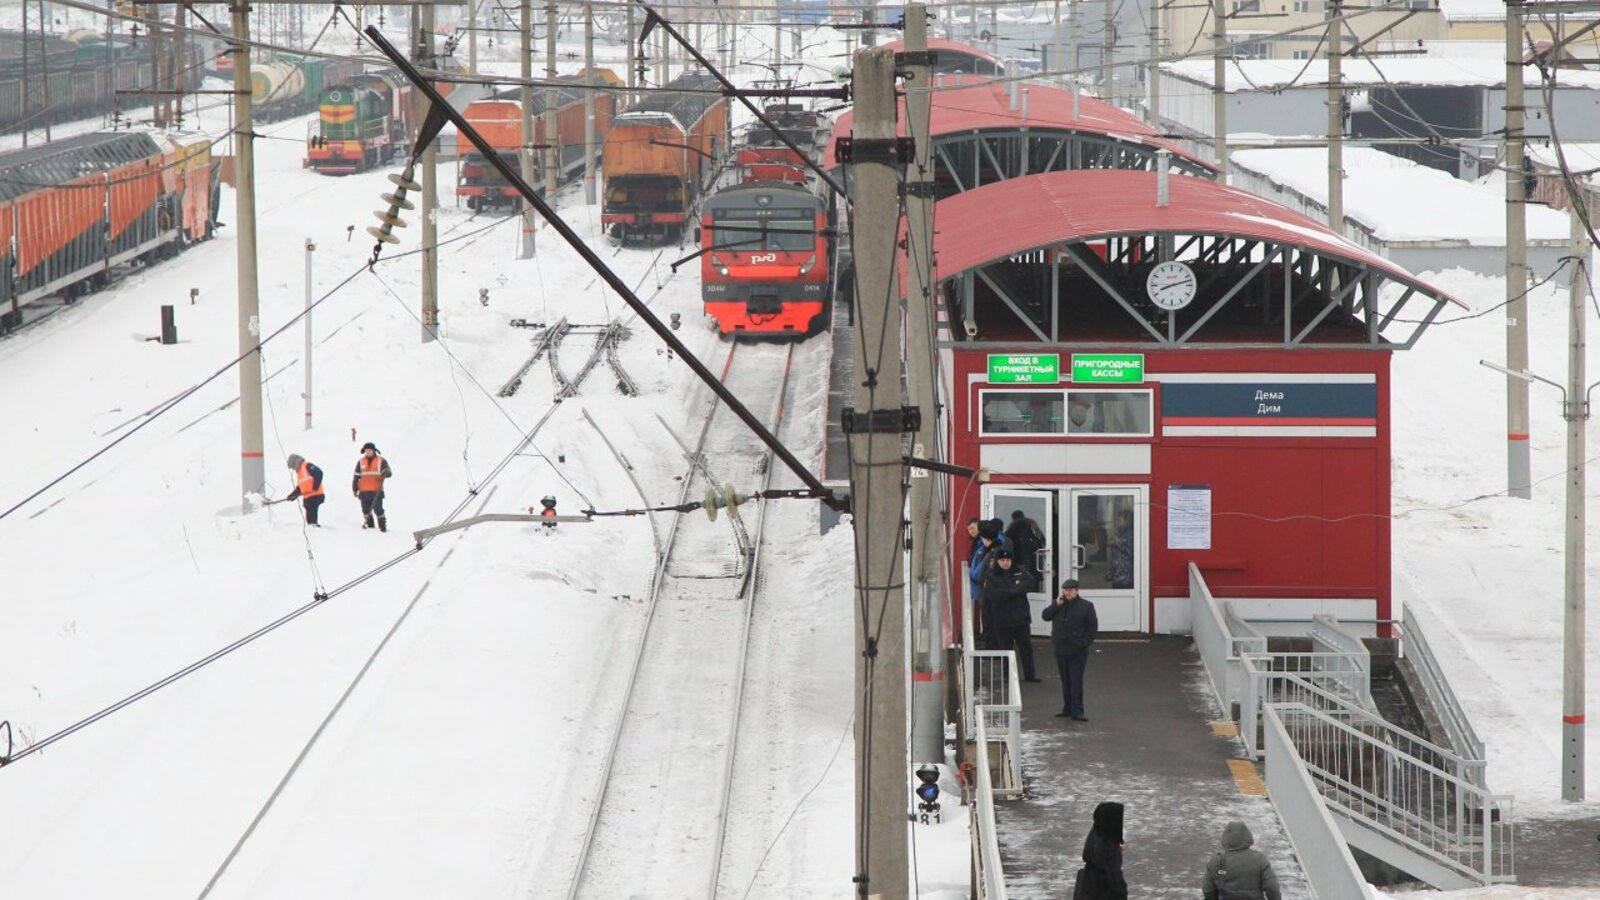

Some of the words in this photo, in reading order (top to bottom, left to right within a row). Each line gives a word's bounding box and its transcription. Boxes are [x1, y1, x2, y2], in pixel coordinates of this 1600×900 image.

[1008, 357, 1031, 365] ВХОД
[1074, 360, 1141, 369] ПРИГОРОДНЫЕ
[993, 365, 1054, 373] ТУРНИКЕТНЫЙ
[1091, 369, 1123, 377] КАССЫ
[1014, 374, 1032, 382] ЗАЛ
[1254, 389, 1284, 401] Дема
[1257, 403, 1281, 415] Дим
